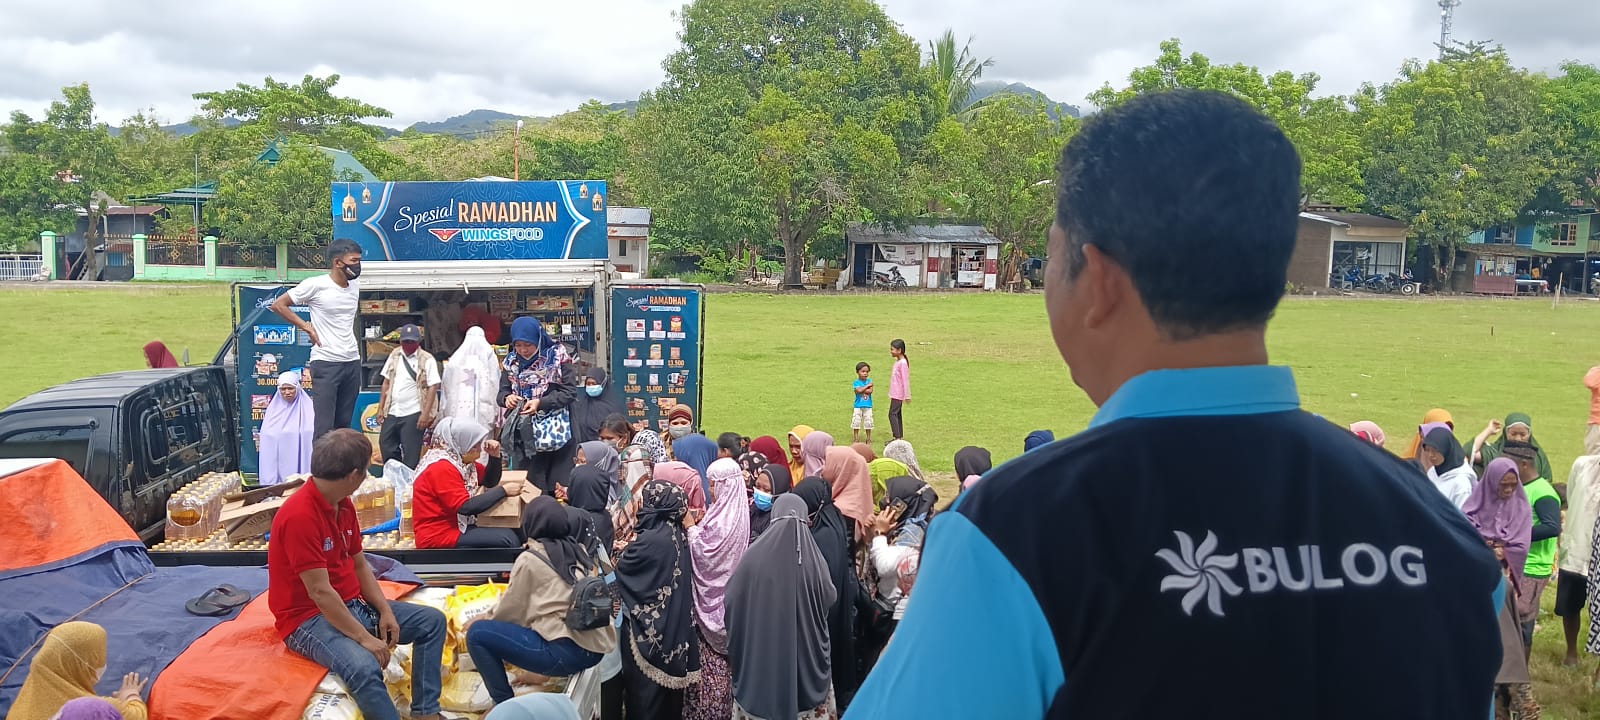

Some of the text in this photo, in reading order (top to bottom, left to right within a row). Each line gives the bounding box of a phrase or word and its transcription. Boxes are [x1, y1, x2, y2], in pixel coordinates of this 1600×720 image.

[393, 198, 558, 233] Spesial RAMADHAN
[461, 227, 544, 242] WINGSFOOD
[649, 296, 687, 306] RAMADHAN
[251, 412, 265, 420] 10.0
[1242, 542, 1428, 593] BULOG
